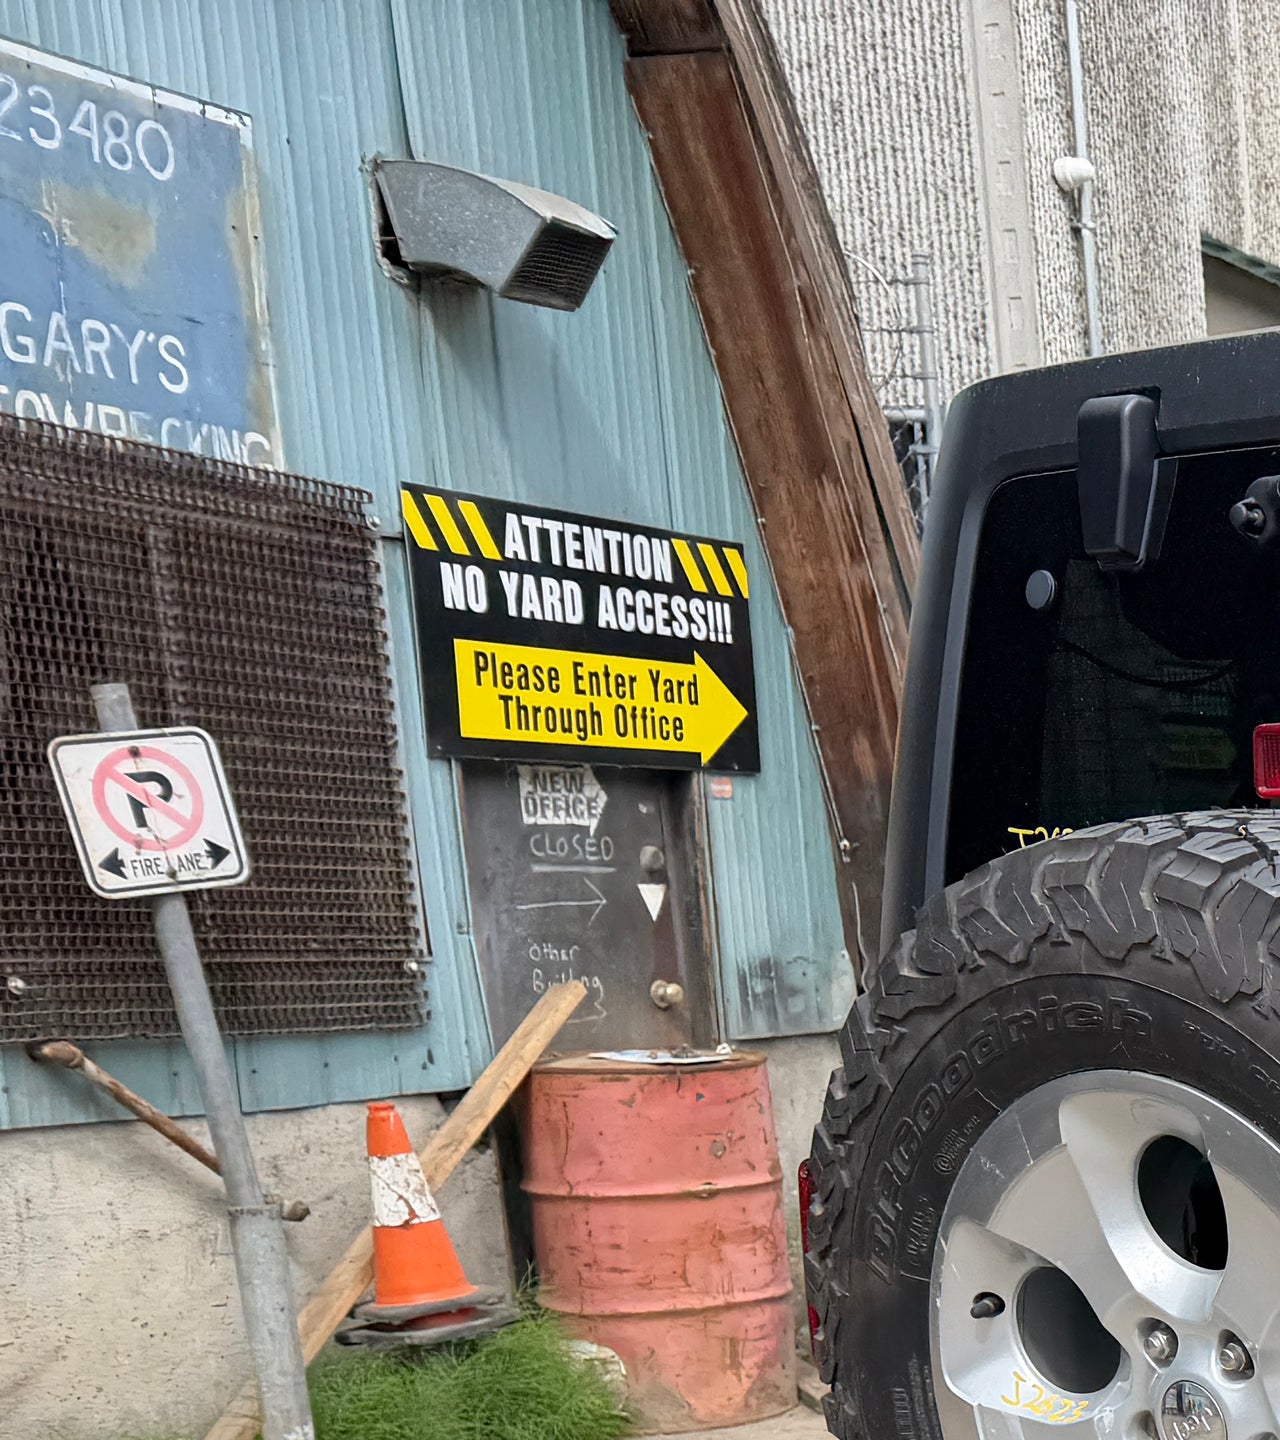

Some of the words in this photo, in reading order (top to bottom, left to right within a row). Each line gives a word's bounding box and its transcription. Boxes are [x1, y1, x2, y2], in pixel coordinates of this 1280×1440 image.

[1, 301, 189, 394] GARY'S
[504, 512, 674, 584] ATTENTION
[440, 561, 489, 614] NO
[499, 569, 585, 625] YARD
[598, 585, 734, 644] ACCESS!!!
[473, 650, 561, 694] Please
[572, 661, 637, 701] Enter
[648, 669, 700, 706] Yard
[498, 694, 602, 742] Through
[614, 704, 684, 742] Office
[524, 792, 602, 821] OFFICE
[533, 772, 584, 793] NEW
[130, 857, 165, 878] FIRE
[166, 853, 210, 876] ANE
[530, 833, 614, 861] CLOSED
[529, 943, 580, 962] Other
[1001, 1371, 1089, 1424] J2623
